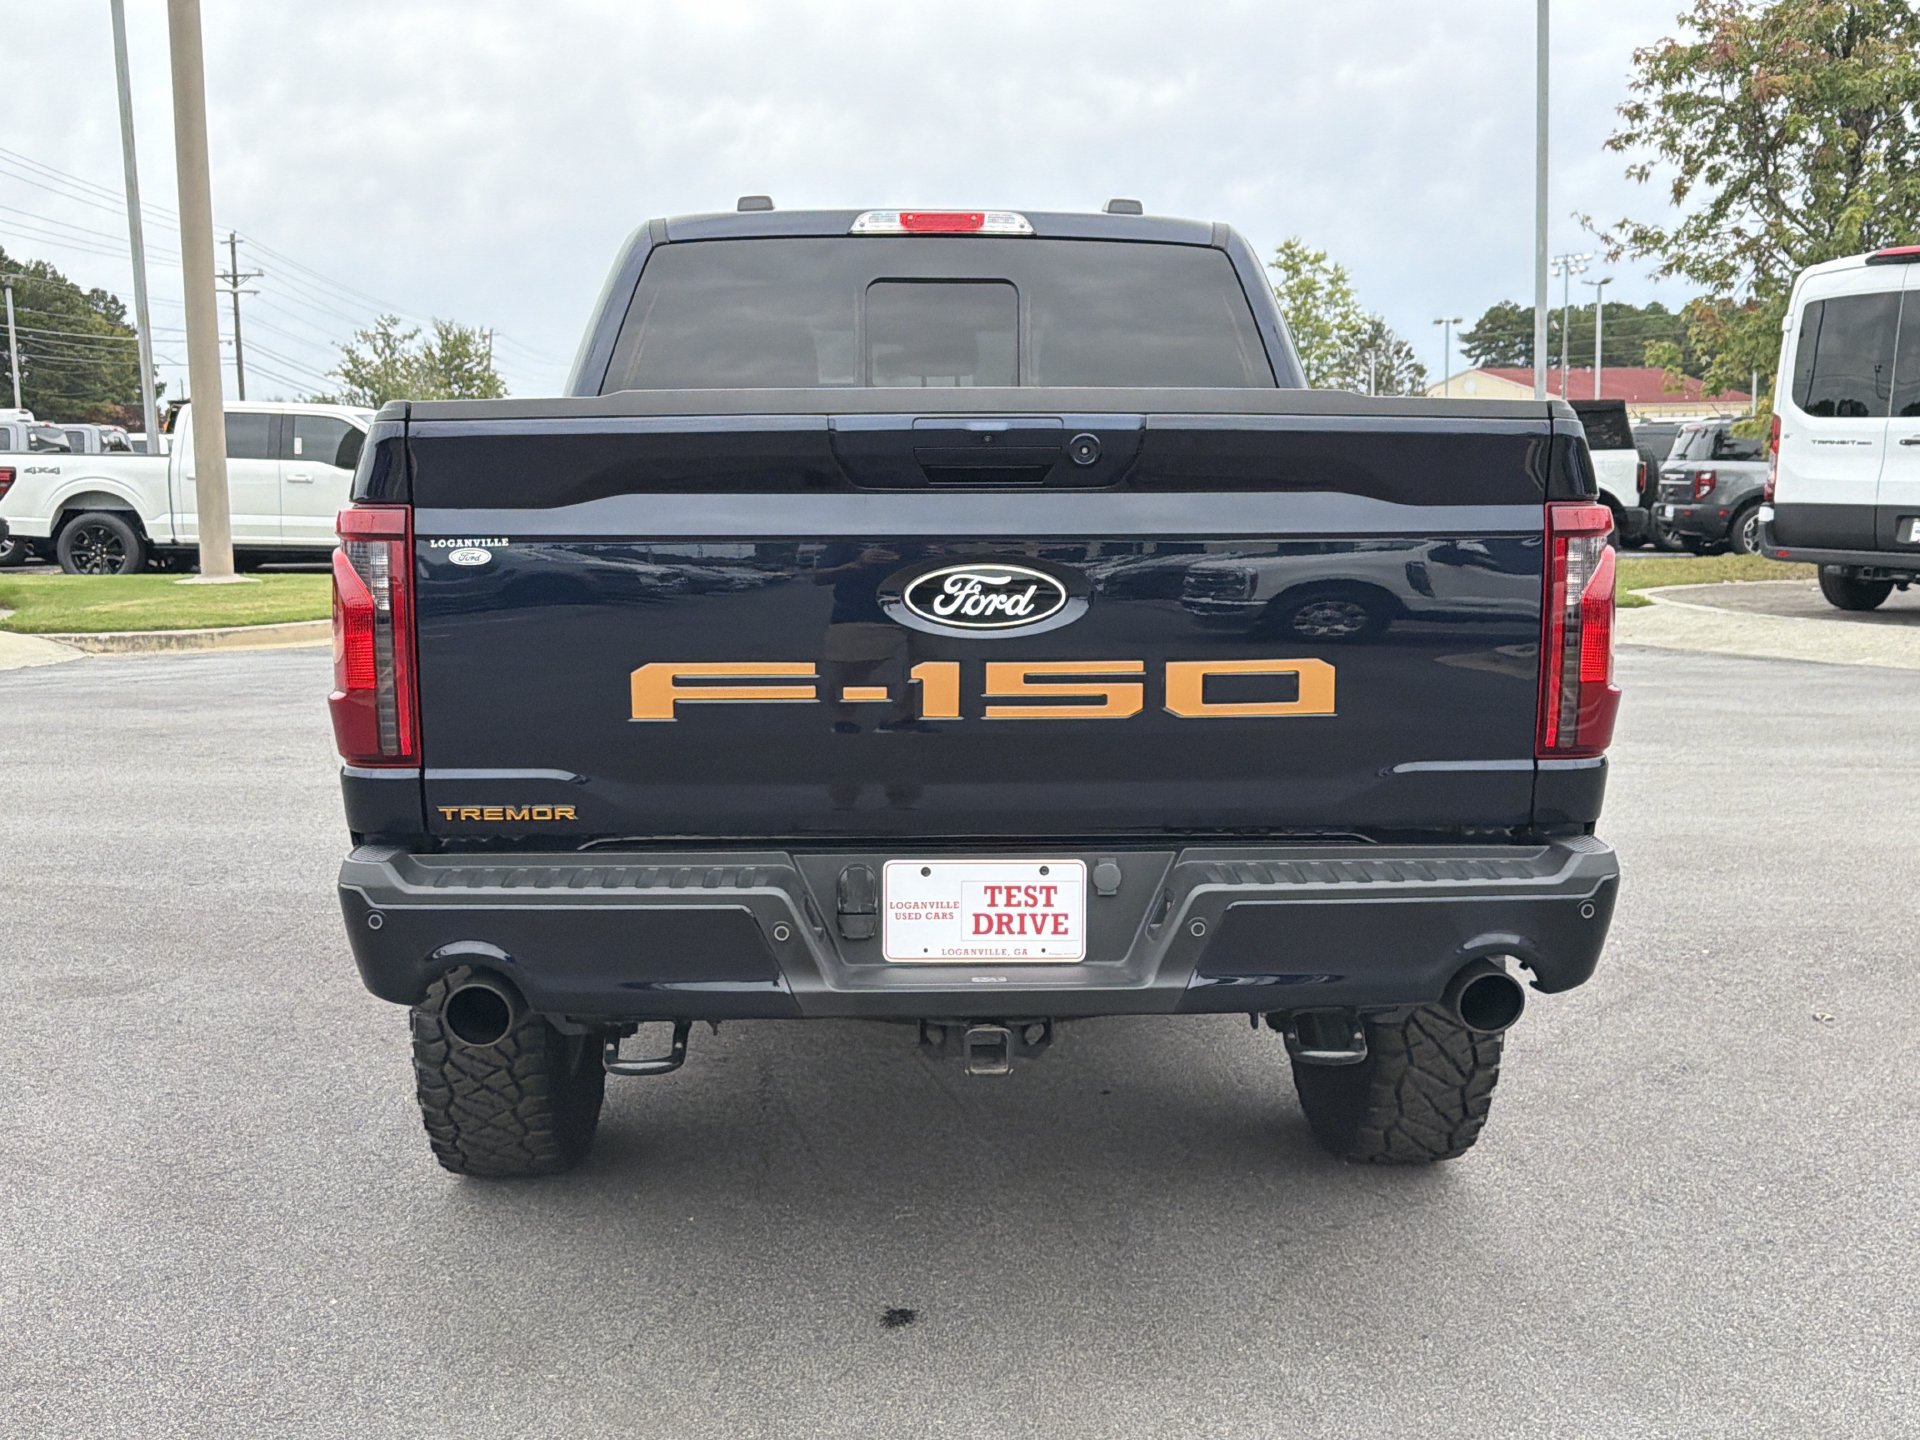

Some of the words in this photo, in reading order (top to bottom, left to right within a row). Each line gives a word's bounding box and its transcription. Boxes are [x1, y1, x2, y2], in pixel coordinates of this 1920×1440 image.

[430, 538, 509, 548] LOGANVILLE
[458, 552, 482, 562] Ford
[933, 574, 1038, 616] Ford
[628, 658, 1338, 722] F-150
[437, 805, 579, 821] TREMOR
[984, 885, 1058, 908] TEST
[889, 901, 960, 910] LOGANVILLE
[895, 912, 922, 920] USED
[925, 912, 954, 920] CARS
[972, 913, 1069, 935] DRIVE
[941, 948, 1011, 957] LOGANVILLE,
[1013, 948, 1029, 956] GA
